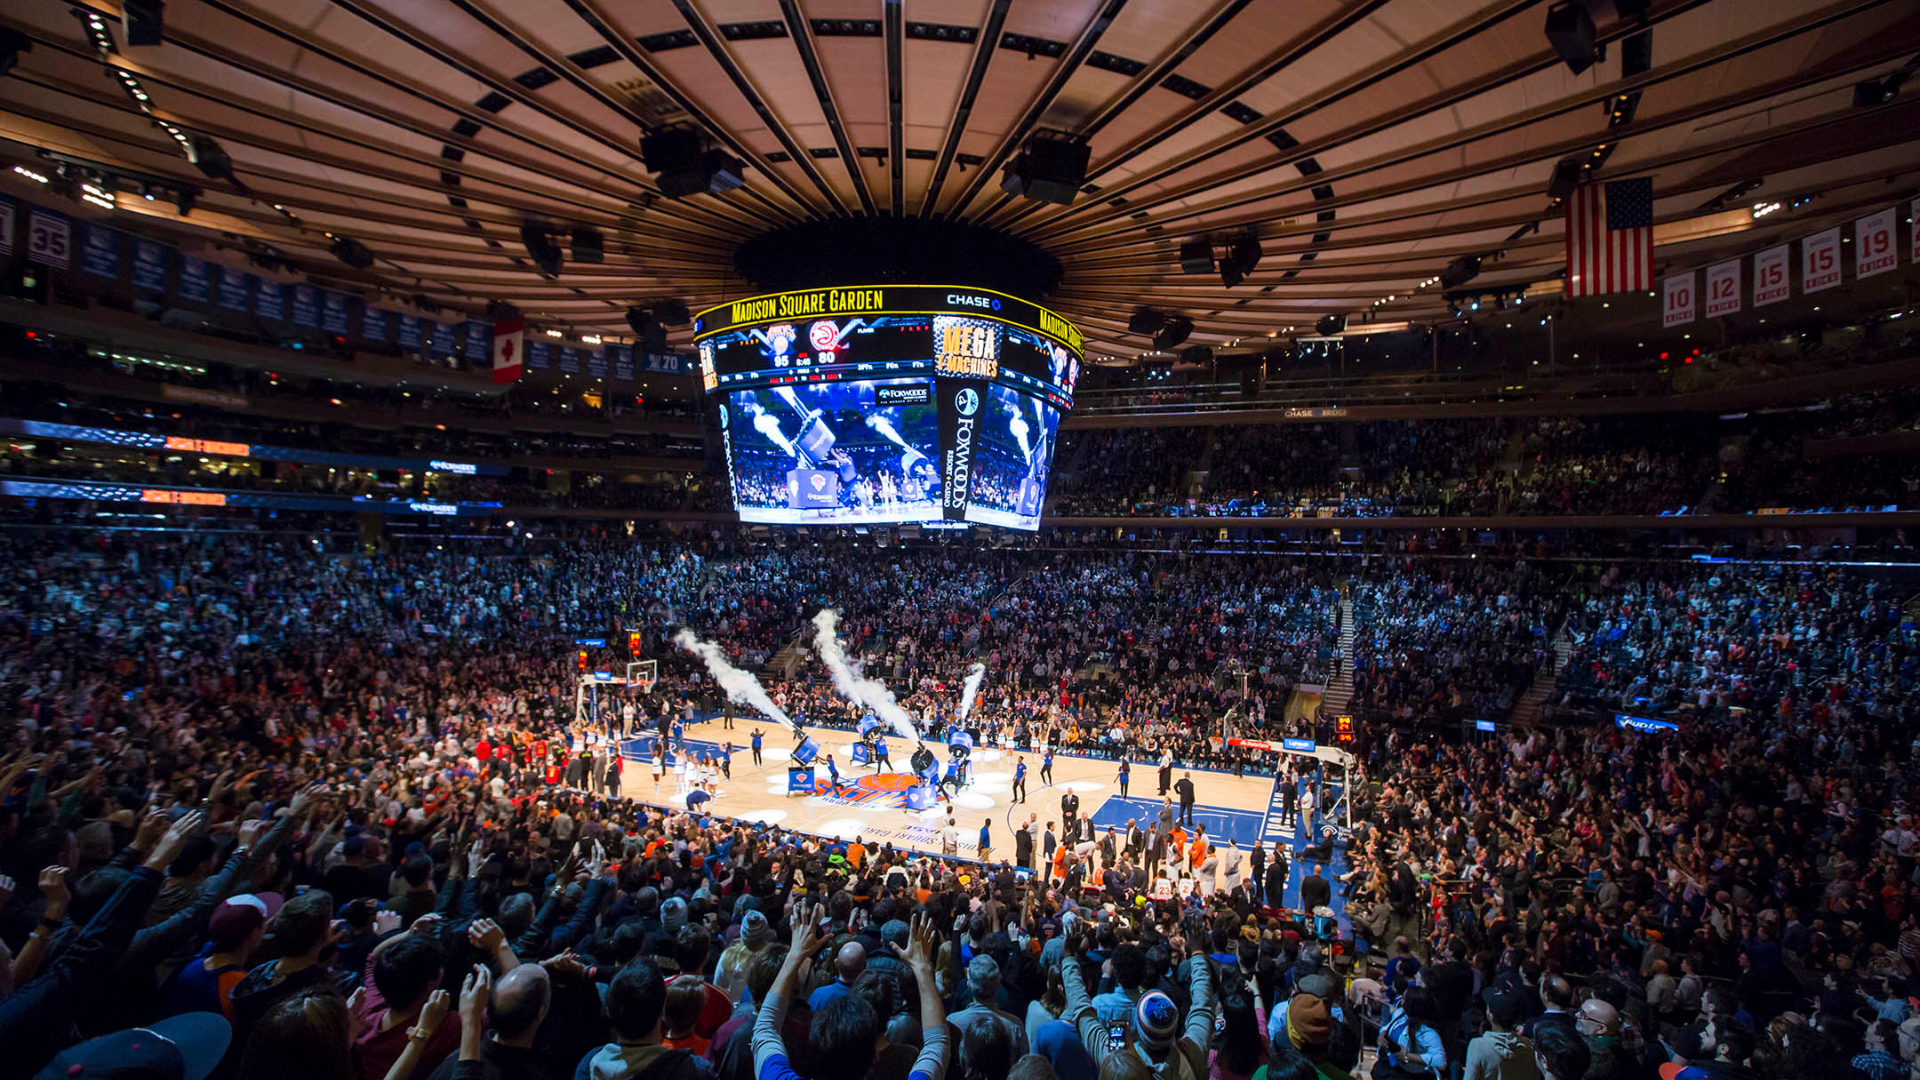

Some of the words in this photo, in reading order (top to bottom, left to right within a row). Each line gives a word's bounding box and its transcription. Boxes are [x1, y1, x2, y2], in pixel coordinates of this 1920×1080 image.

[33, 227, 66, 257] 35
[1862, 230, 1889, 258] 19
[1808, 247, 1833, 274] 15
[1859, 254, 1895, 274] KNICKS
[1760, 262, 1782, 288] 15
[1805, 271, 1839, 290] KNICKS
[1712, 276, 1735, 300] 12
[1756, 286, 1788, 303] KNICKS
[731, 298, 776, 324] MADISON
[779, 293, 826, 317] SQUARE
[829, 289, 883, 312] GARDEN
[946, 294, 991, 309] CHASE
[1669, 288, 1690, 310] 10
[1708, 299, 1739, 314] KNICKS
[1665, 310, 1693, 324] KNICKS
[942, 326, 995, 359] MEGA
[663, 355, 678, 369] 70
[774, 355, 789, 367] 95
[819, 351, 835, 363] 80
[890, 389, 928, 398] FOXWOODS
[1322, 409, 1347, 417] BRIDGE
[723, 429, 739, 511] FOXWOODS
[946, 450, 954, 477] RESORT
[952, 417, 974, 510] FOXWOODS
[944, 481, 953, 508] CASINO
[1265, 811, 1298, 840] YORK
[893, 832, 938, 845] SQUARE
[1159, 886, 1170, 896] 23
